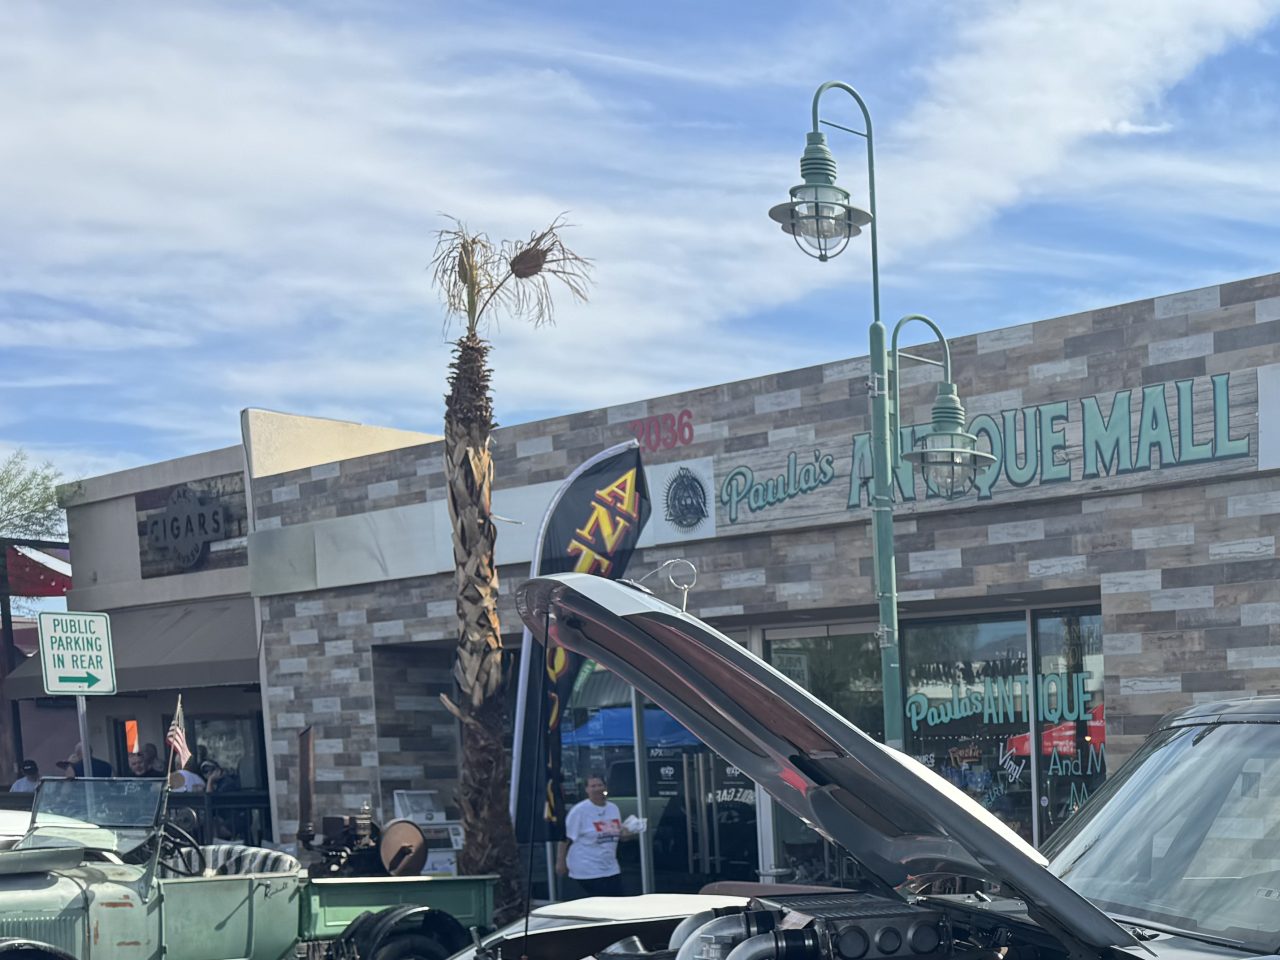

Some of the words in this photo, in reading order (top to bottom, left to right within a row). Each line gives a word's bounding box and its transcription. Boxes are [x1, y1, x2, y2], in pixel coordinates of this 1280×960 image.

[720, 449, 835, 524] Paula's
[847, 400, 1072, 510] ANQUE
[1080, 372, 1250, 480] MALL
[150, 510, 220, 542] CIGARS
[52, 618, 96, 635] PUBLIC
[50, 636, 102, 652] PARKING
[52, 654, 65, 669] IN
[71, 654, 103, 670] REAR
[905, 682, 983, 732] Paula's
[983, 672, 1093, 724] ANTIQUE
[999, 742, 1026, 783] Vinyl
[1048, 744, 1082, 776] And
